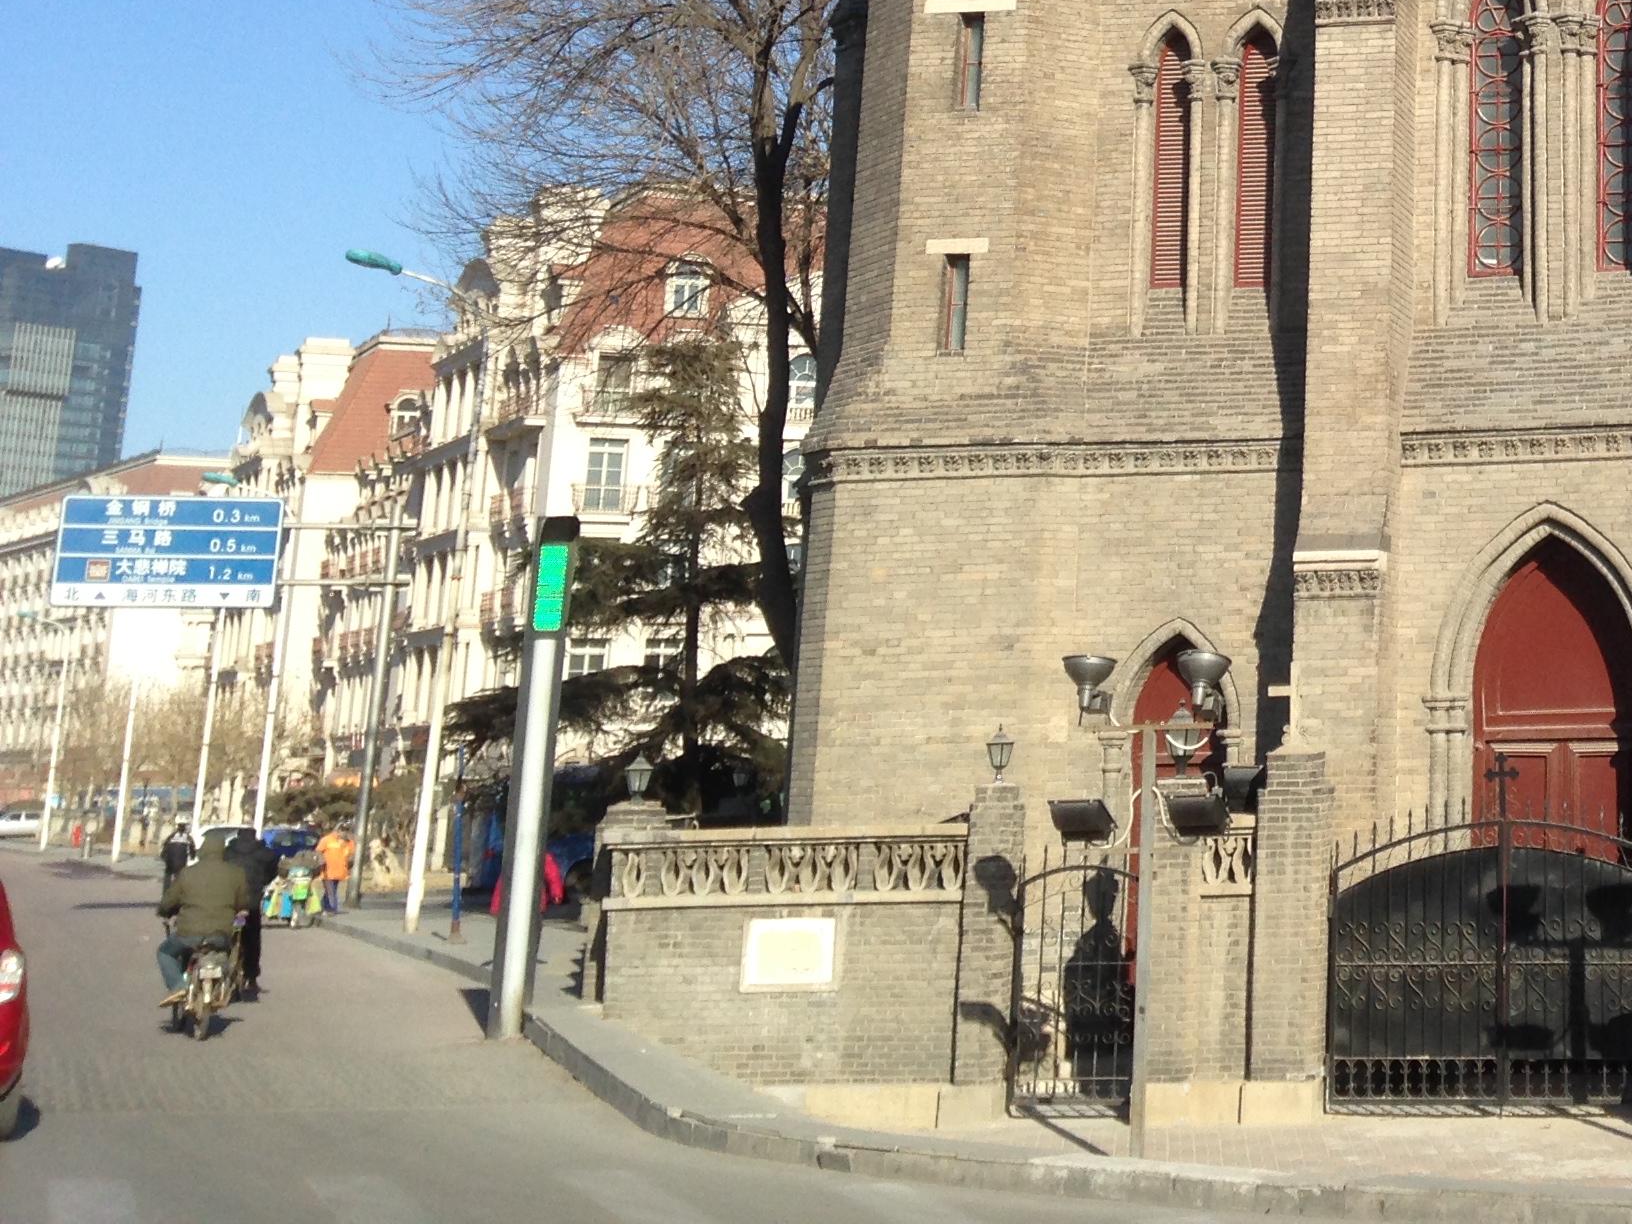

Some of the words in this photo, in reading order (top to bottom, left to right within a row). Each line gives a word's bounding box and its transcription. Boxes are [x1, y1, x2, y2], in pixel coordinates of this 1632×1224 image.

[213, 508, 242, 523] 0.3
[244, 513, 260, 523] km
[101, 529, 173, 546] 三马路
[209, 538, 237, 553] 0.5
[240, 544, 257, 553] km
[115, 558, 187, 576] 大悲禅院
[208, 565, 231, 581] 1.2
[237, 571, 254, 581] km
[63, 588, 80, 602] 北
[121, 588, 198, 603] 海河东路
[245, 589, 261, 603] 南
